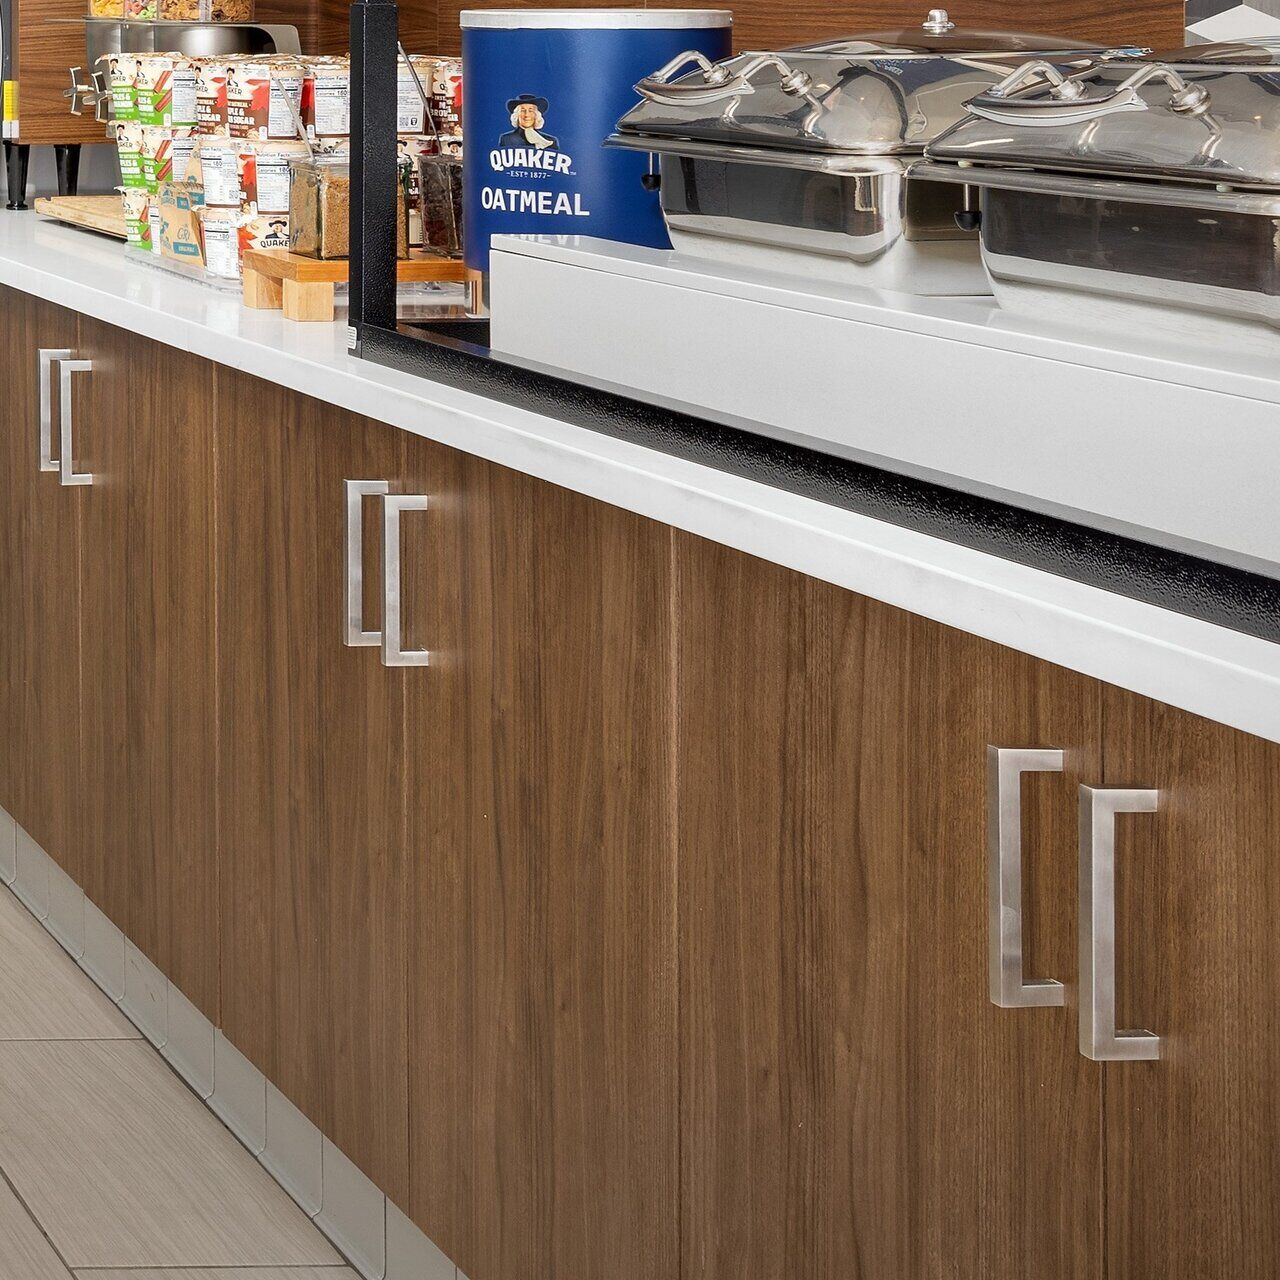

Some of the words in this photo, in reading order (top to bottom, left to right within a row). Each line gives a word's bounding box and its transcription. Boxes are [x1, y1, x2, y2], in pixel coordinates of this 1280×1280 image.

[490, 147, 572, 175] QUAKER
[481, 186, 590, 216] OATMEAL
[260, 239, 290, 248] QUAKE
